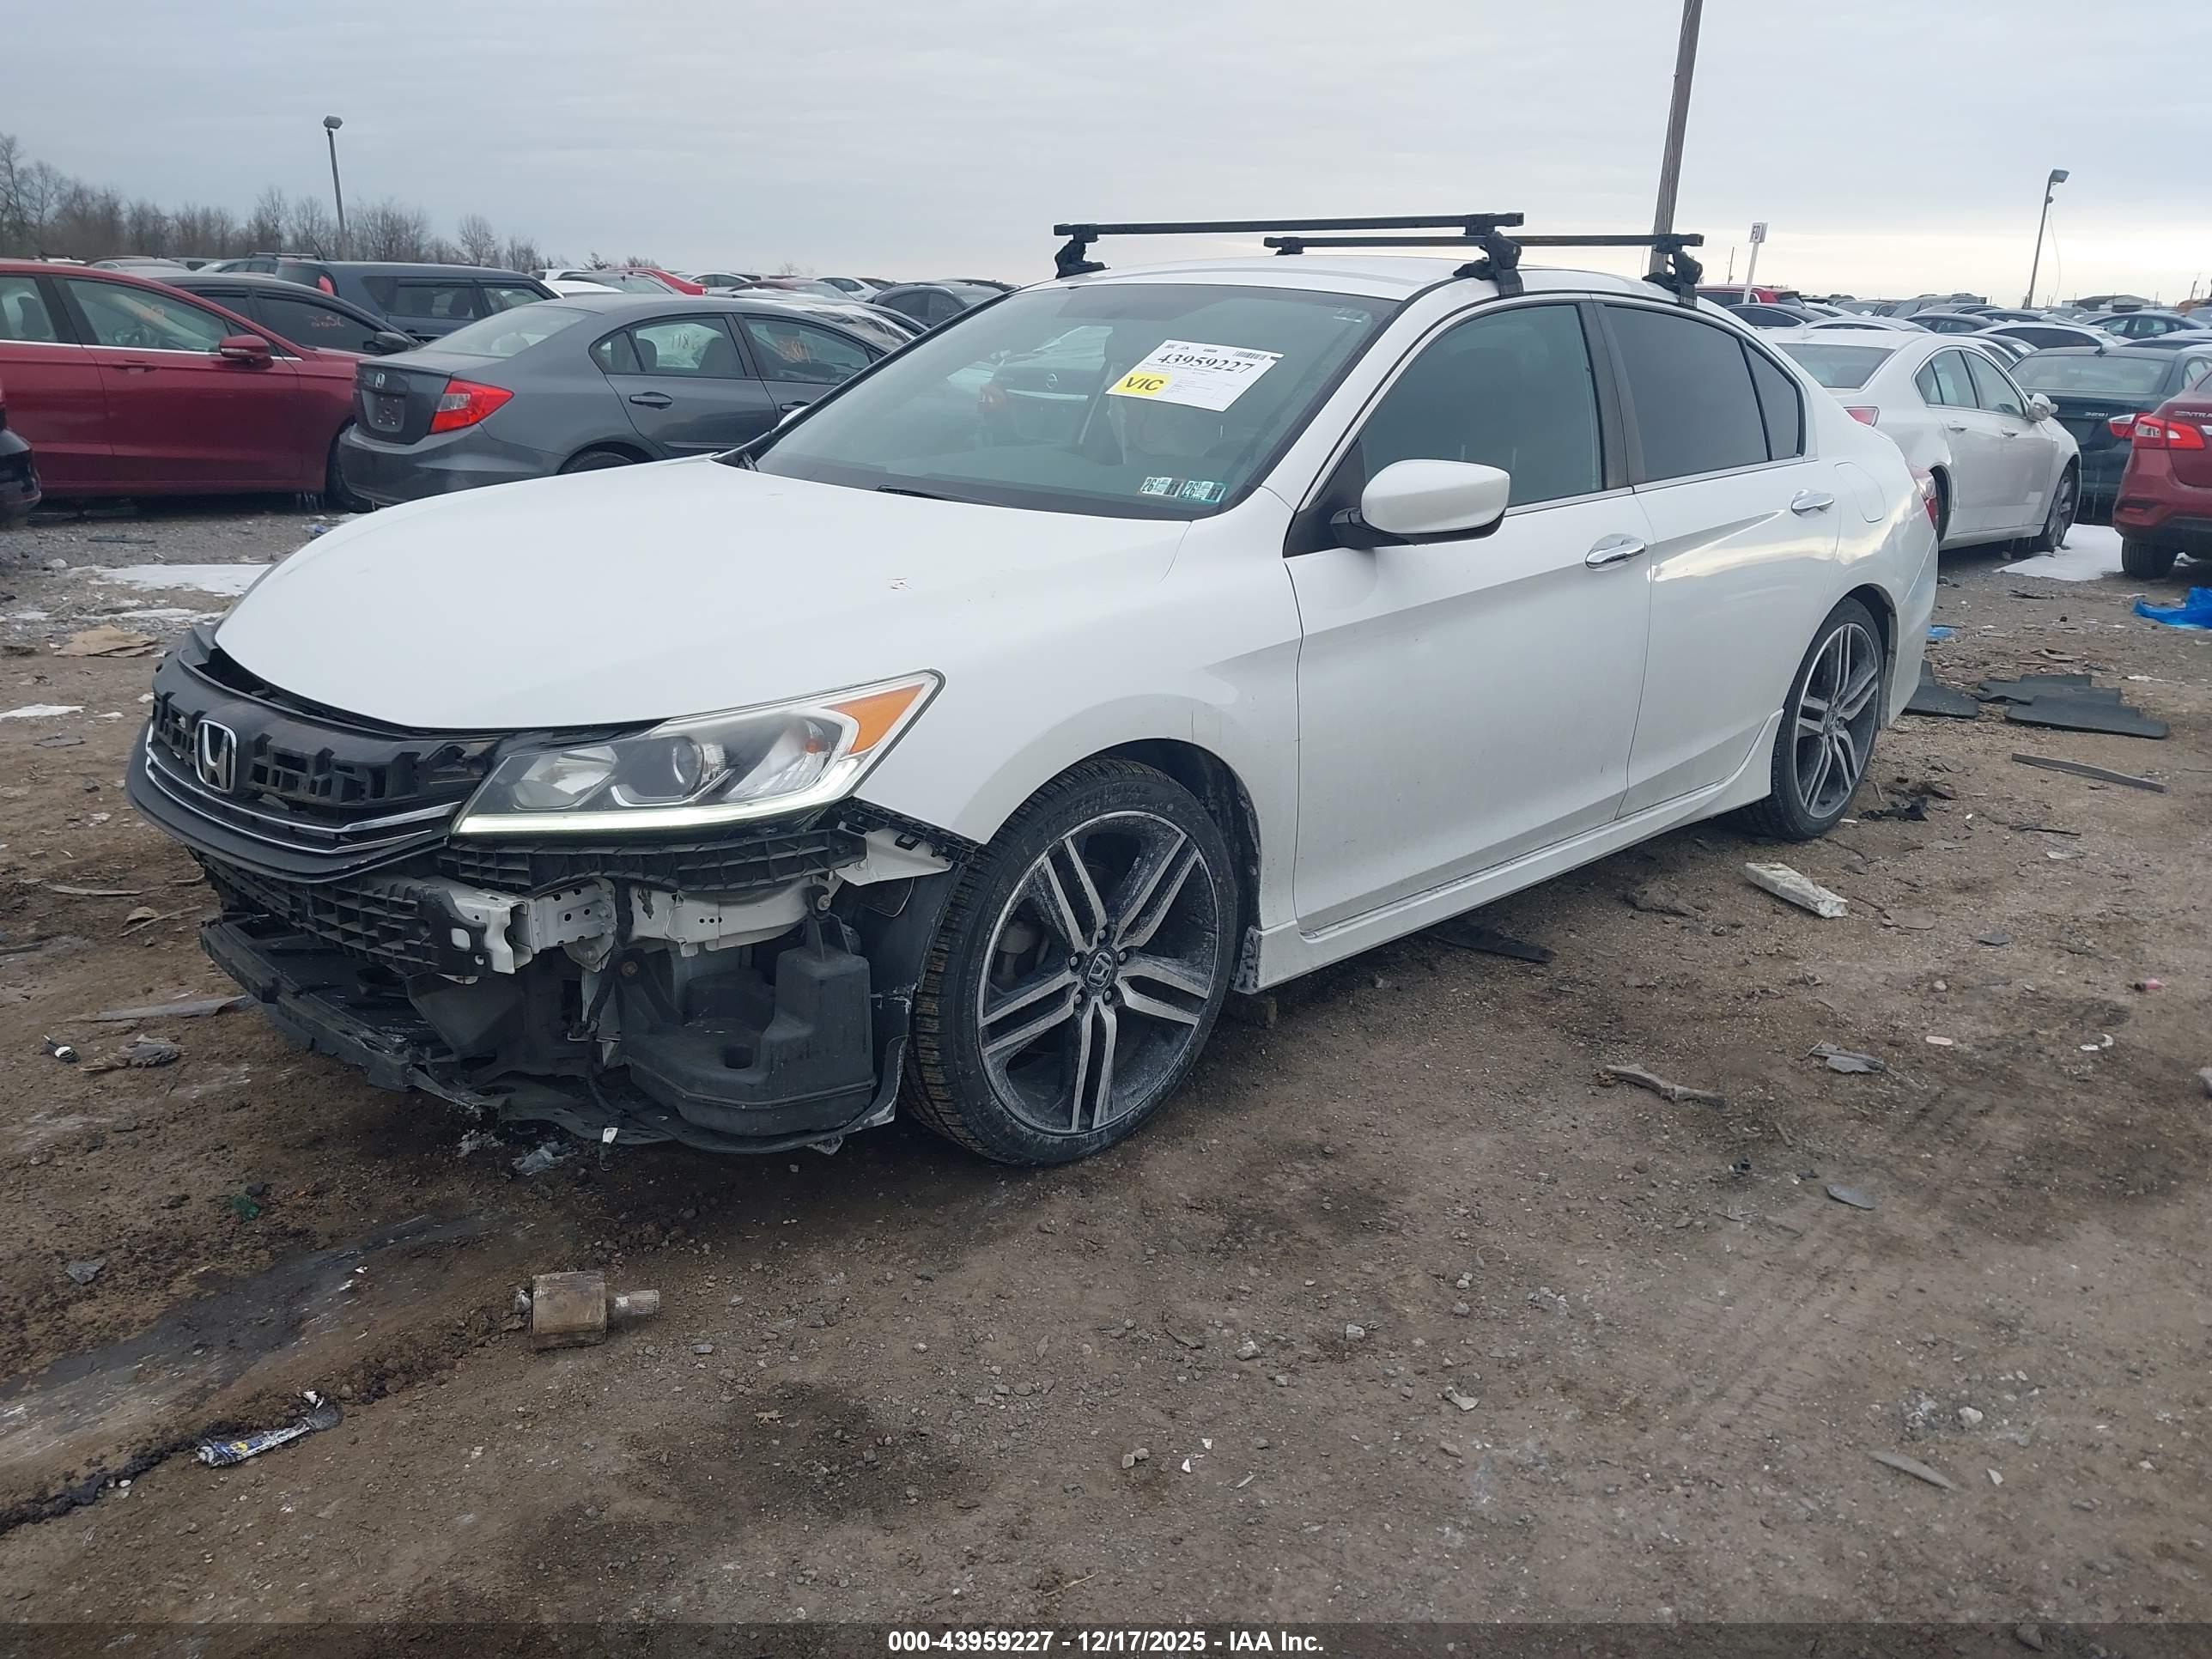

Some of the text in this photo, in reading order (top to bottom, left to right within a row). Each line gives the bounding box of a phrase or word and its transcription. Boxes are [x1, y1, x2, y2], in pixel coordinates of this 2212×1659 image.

[1752, 225, 1760, 240] FD
[1158, 353, 1256, 374] 43959227
[1125, 376, 1164, 392] VIC
